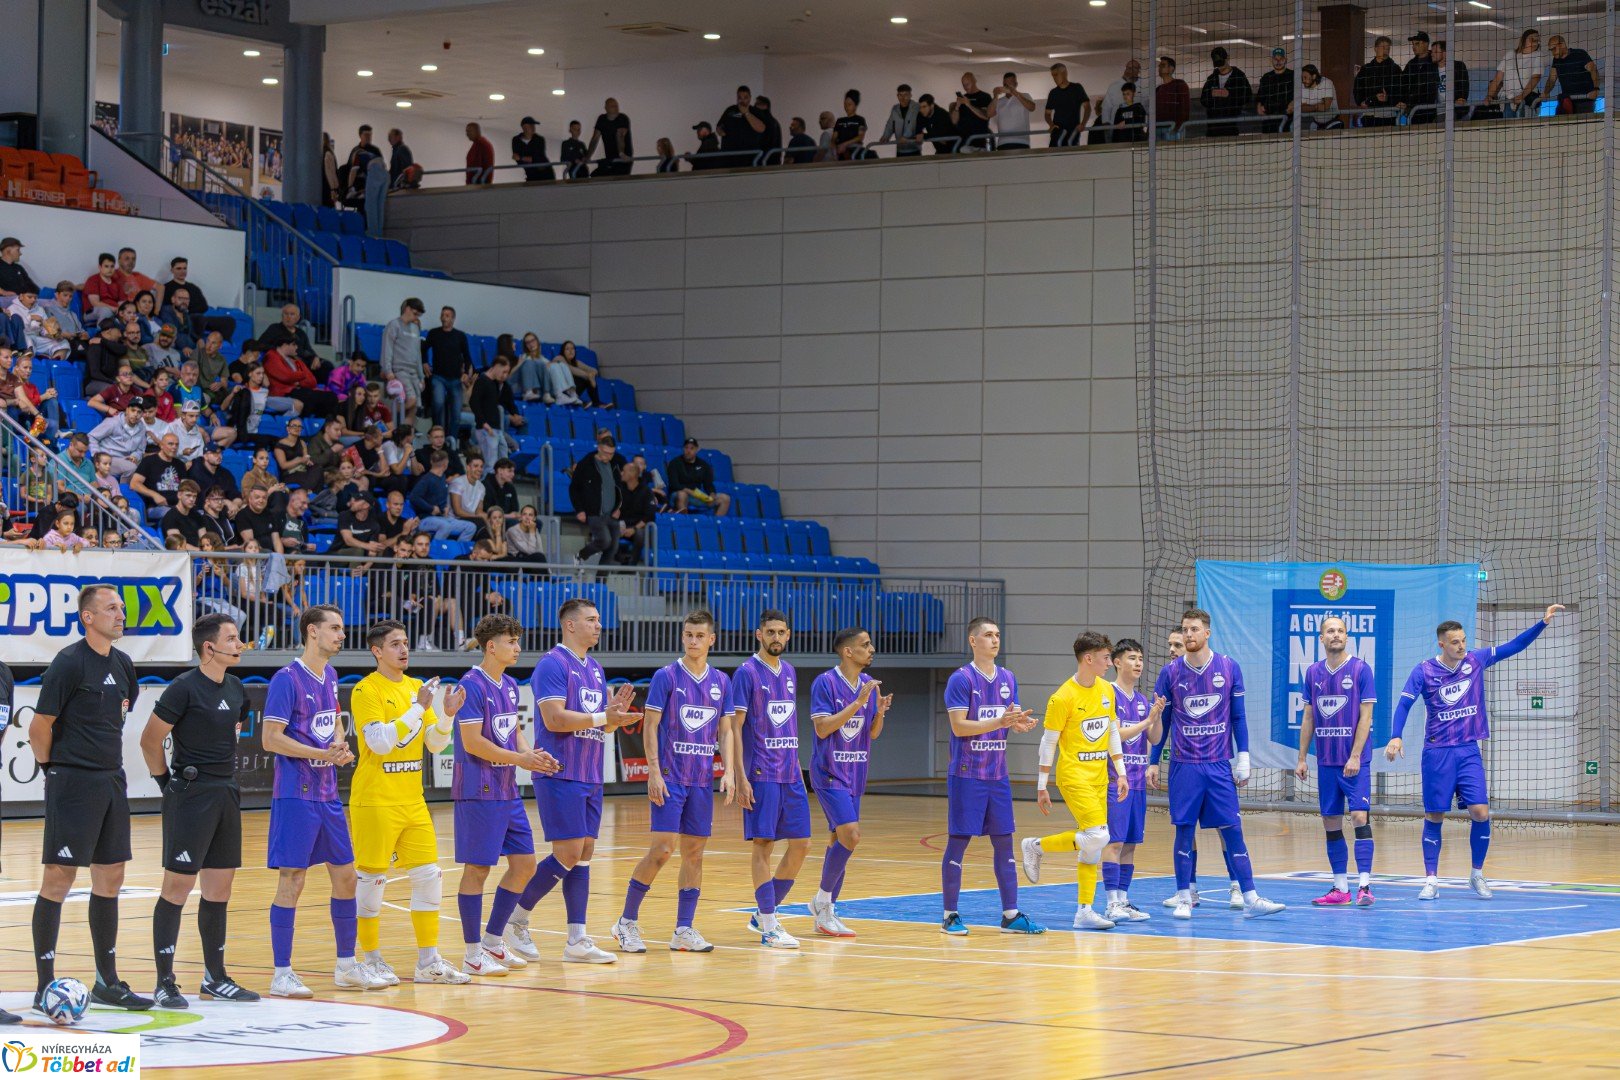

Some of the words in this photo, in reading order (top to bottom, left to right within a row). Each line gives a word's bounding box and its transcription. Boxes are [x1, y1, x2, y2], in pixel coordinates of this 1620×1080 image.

[1290, 614, 1300, 632] A
[1445, 685, 1461, 696] MOL
[1190, 698, 1210, 708] MOL
[685, 709, 704, 720] MOL
[980, 709, 998, 719] MOL
[316, 715, 334, 728] MOL
[1087, 720, 1104, 731] MOL
